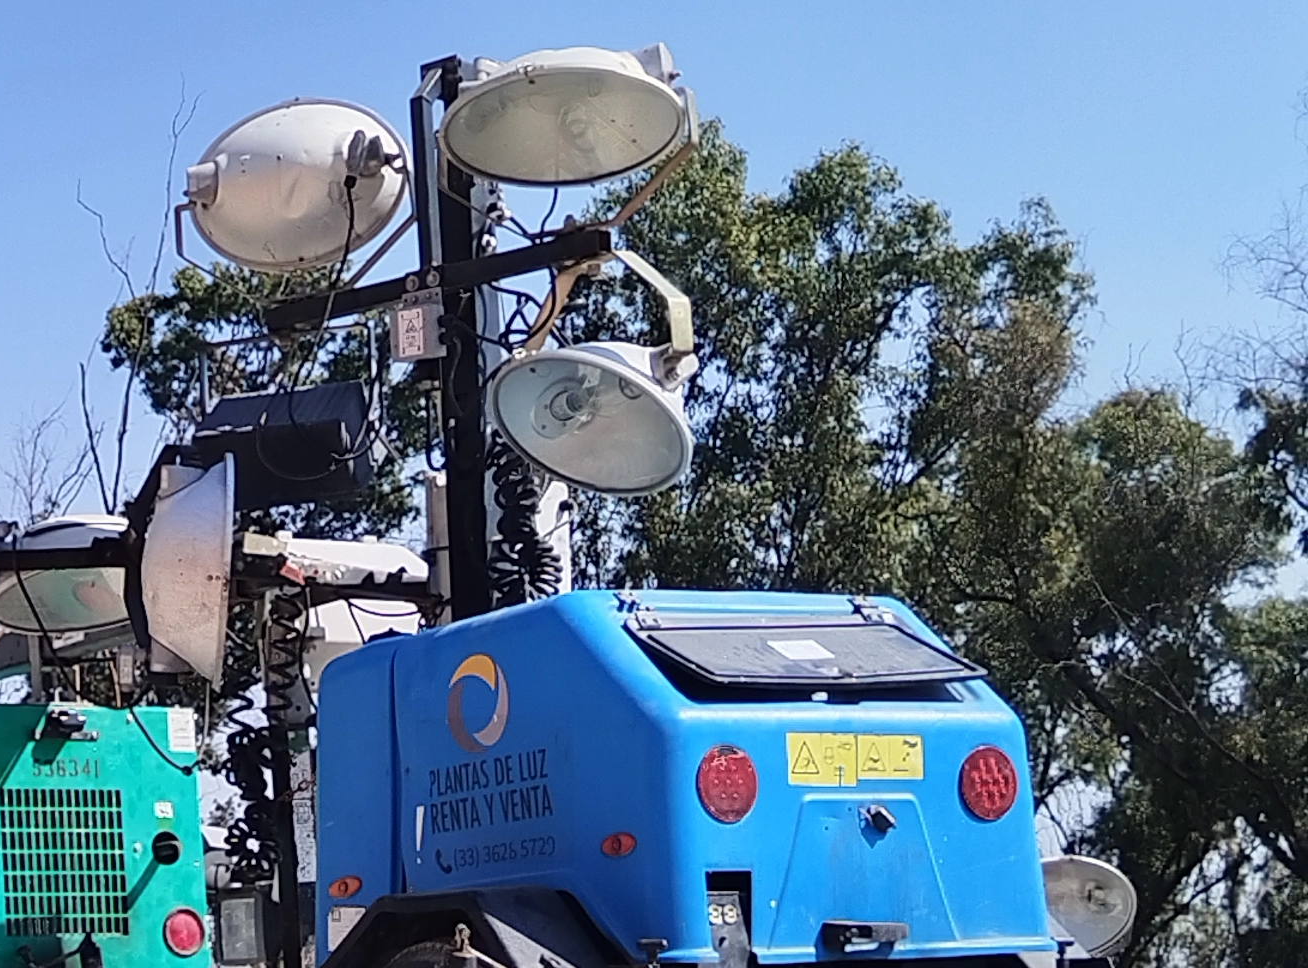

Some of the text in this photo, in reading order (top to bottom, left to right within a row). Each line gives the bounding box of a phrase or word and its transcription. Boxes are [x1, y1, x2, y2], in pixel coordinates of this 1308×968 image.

[32, 758, 98, 779] 536341
[429, 748, 548, 798] PLANTAS DE LUZ
[430, 784, 553, 835] RENTA Y VENTA
[453, 845, 480, 872] (33)
